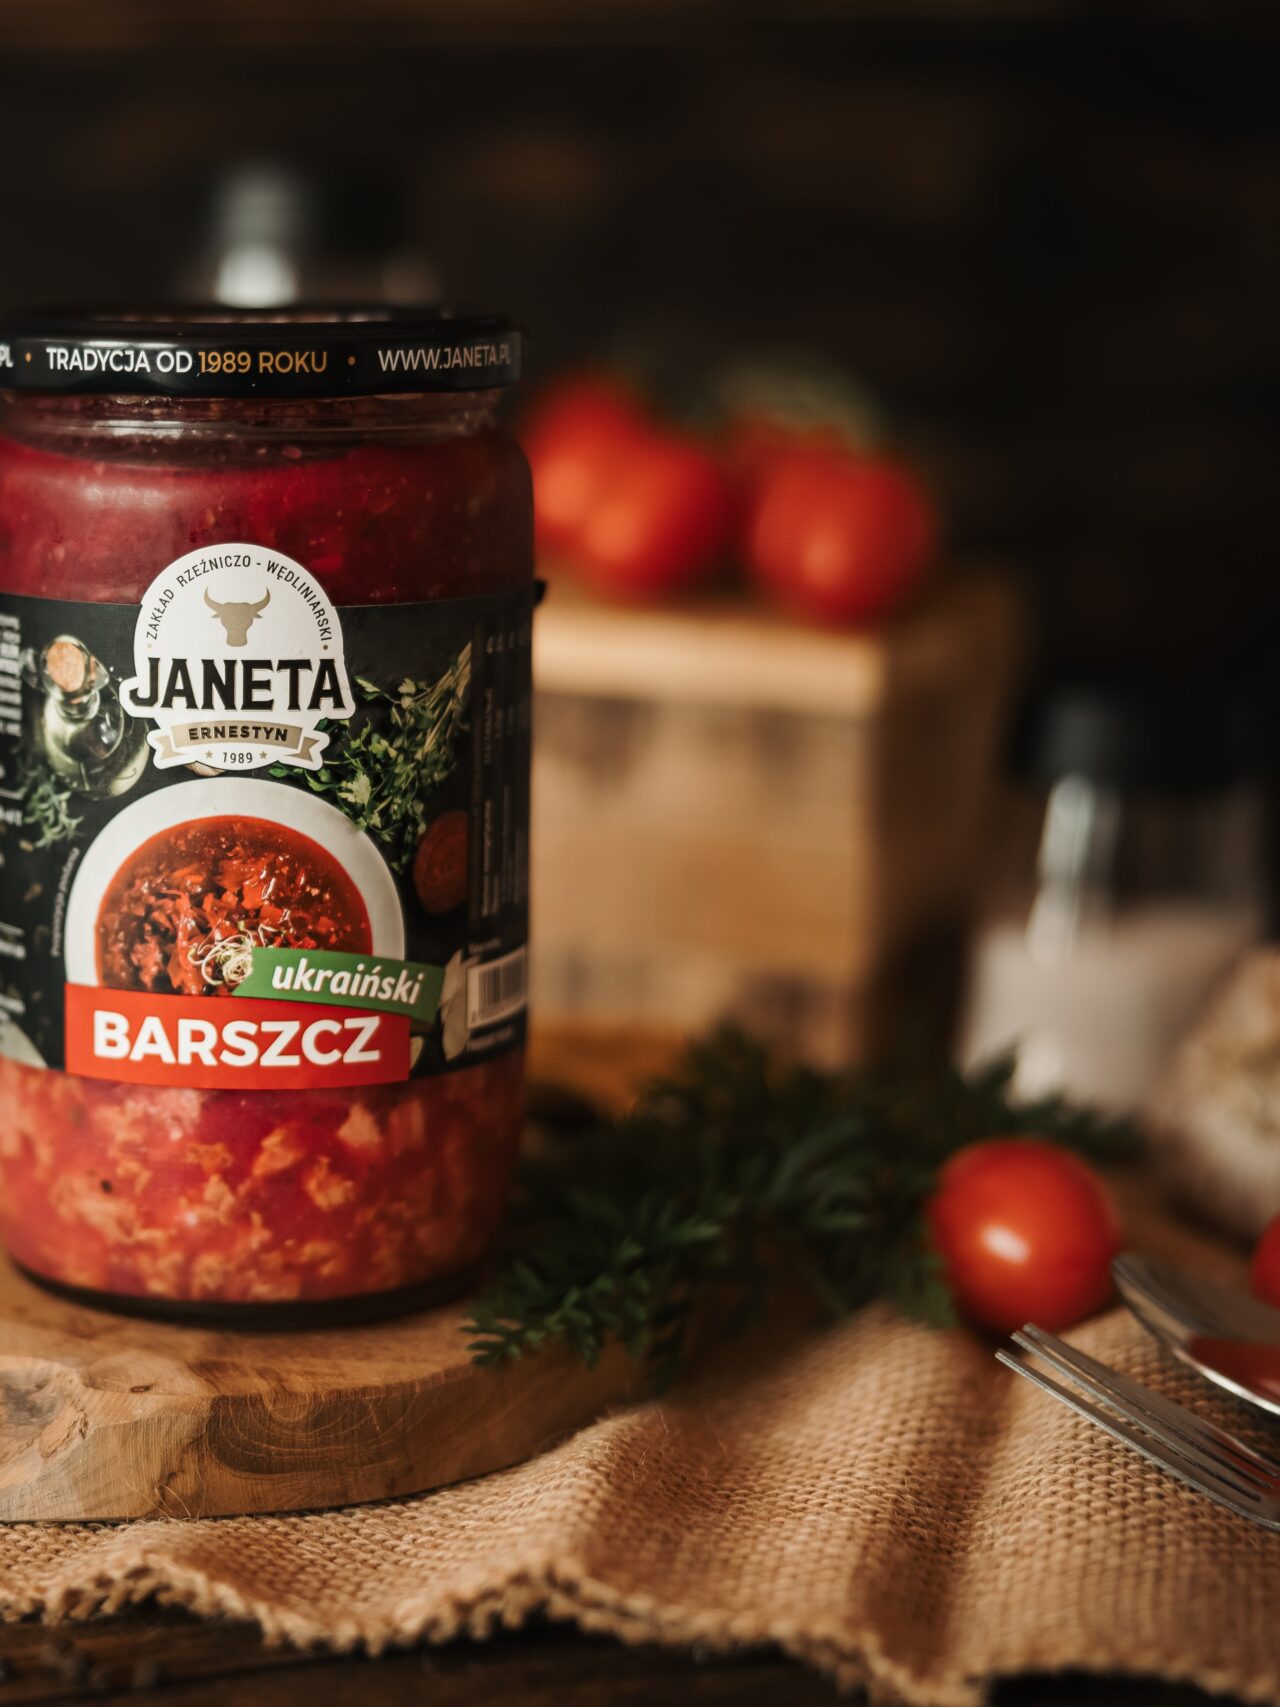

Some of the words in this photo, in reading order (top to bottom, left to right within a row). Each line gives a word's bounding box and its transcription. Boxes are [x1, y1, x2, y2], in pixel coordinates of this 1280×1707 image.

[46, 346, 151, 373] TRADYCJA
[156, 350, 193, 373] OD
[198, 351, 251, 373] 1989
[258, 351, 327, 373] ROKU
[377, 344, 511, 372] WWW.JANETA.PL
[145, 588, 175, 641] ZAKŁAD
[176, 554, 252, 588] RZEŹNICZO
[266, 559, 333, 642] WĘDLINIARSKI
[128, 656, 348, 711] JANETA
[188, 725, 289, 743] ERNESTYN
[222, 752, 254, 764] 1989
[271, 957, 424, 1005] ukraiński
[92, 1009, 381, 1067] BARSZCZ
